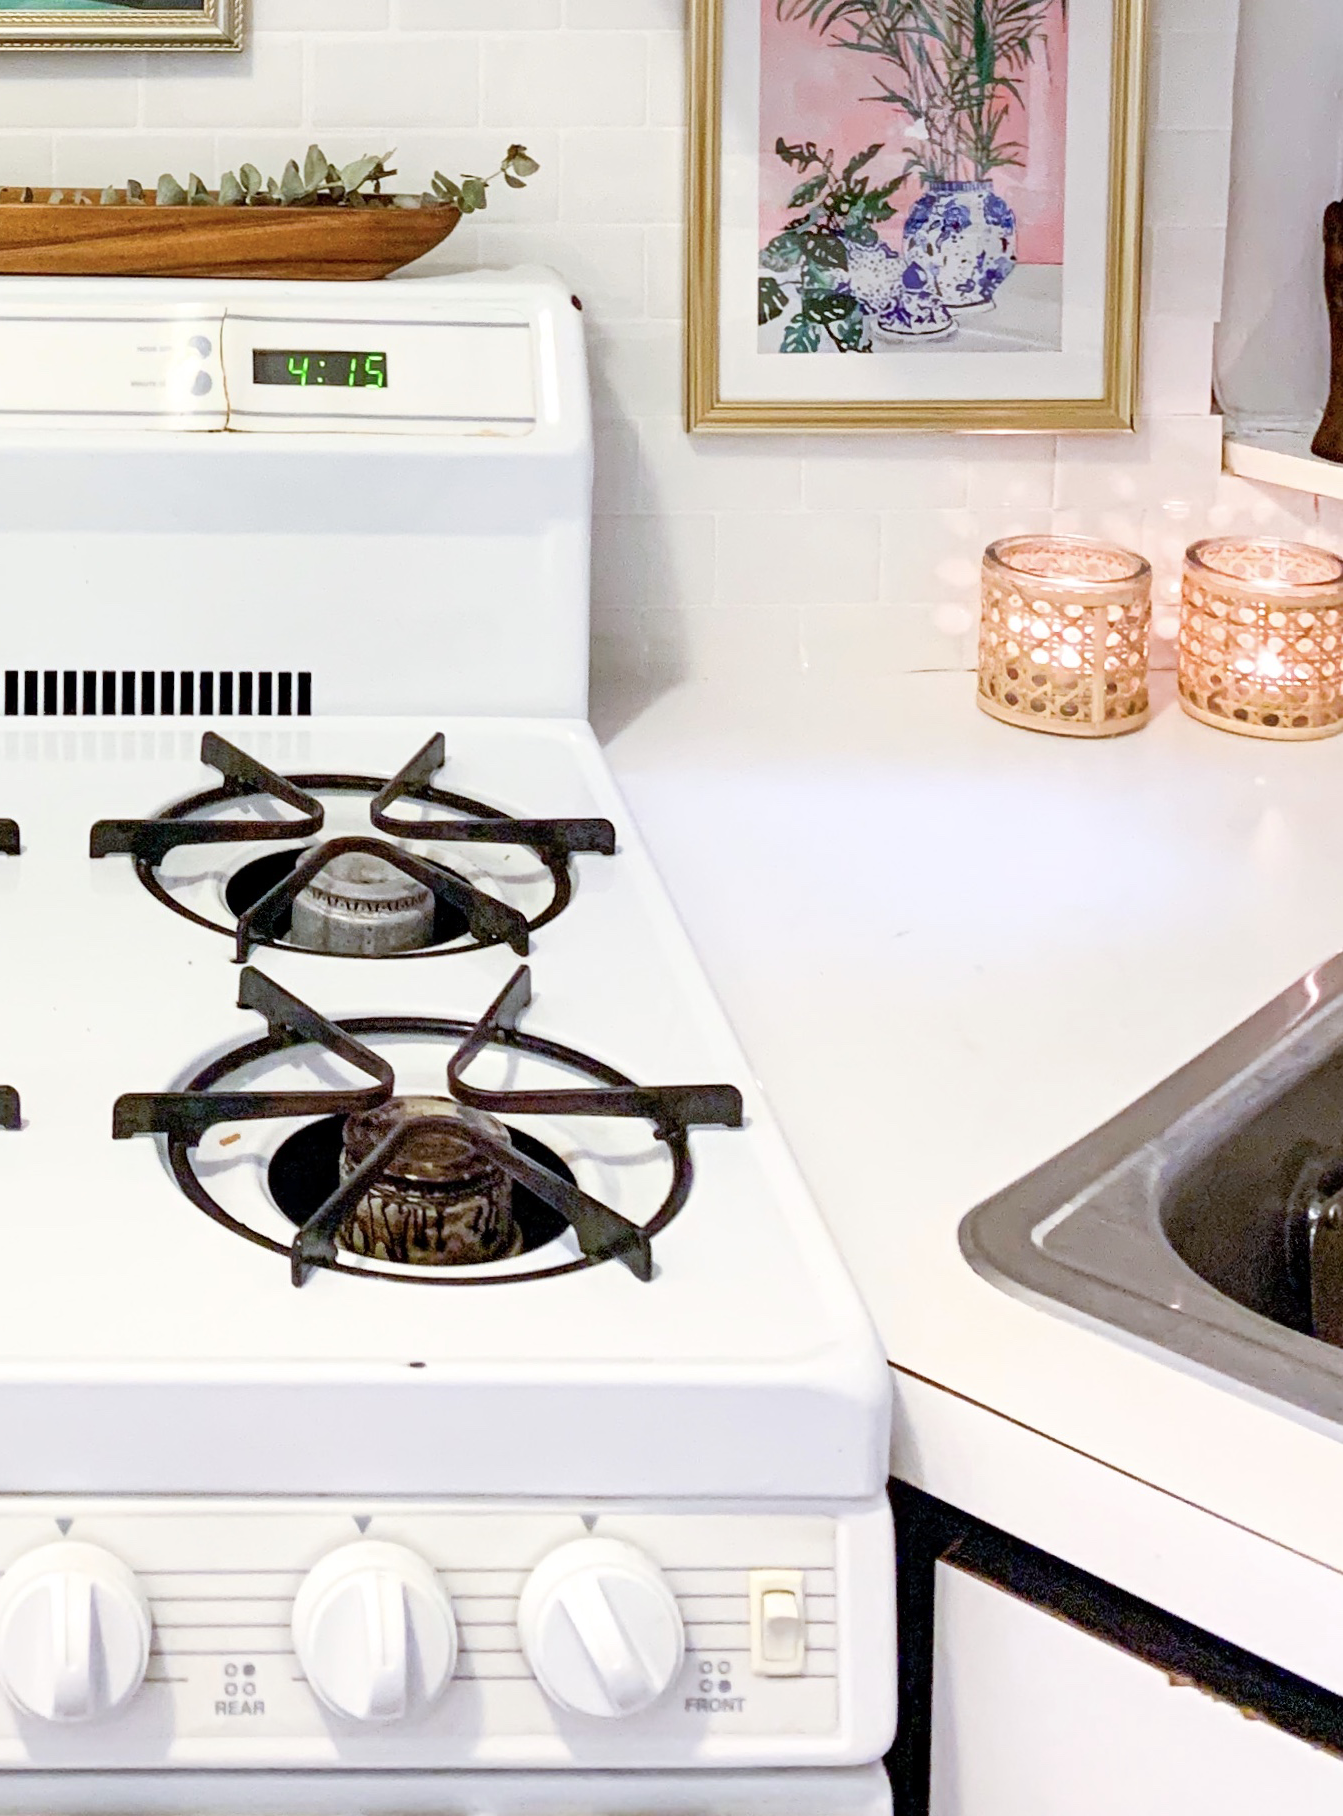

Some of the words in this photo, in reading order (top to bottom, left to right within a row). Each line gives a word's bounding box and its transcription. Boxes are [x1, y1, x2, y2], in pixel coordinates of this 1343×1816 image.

[288, 355, 384, 390] 4:15
[214, 1700, 266, 1717] REAR
[685, 1697, 747, 1713] FRONT
